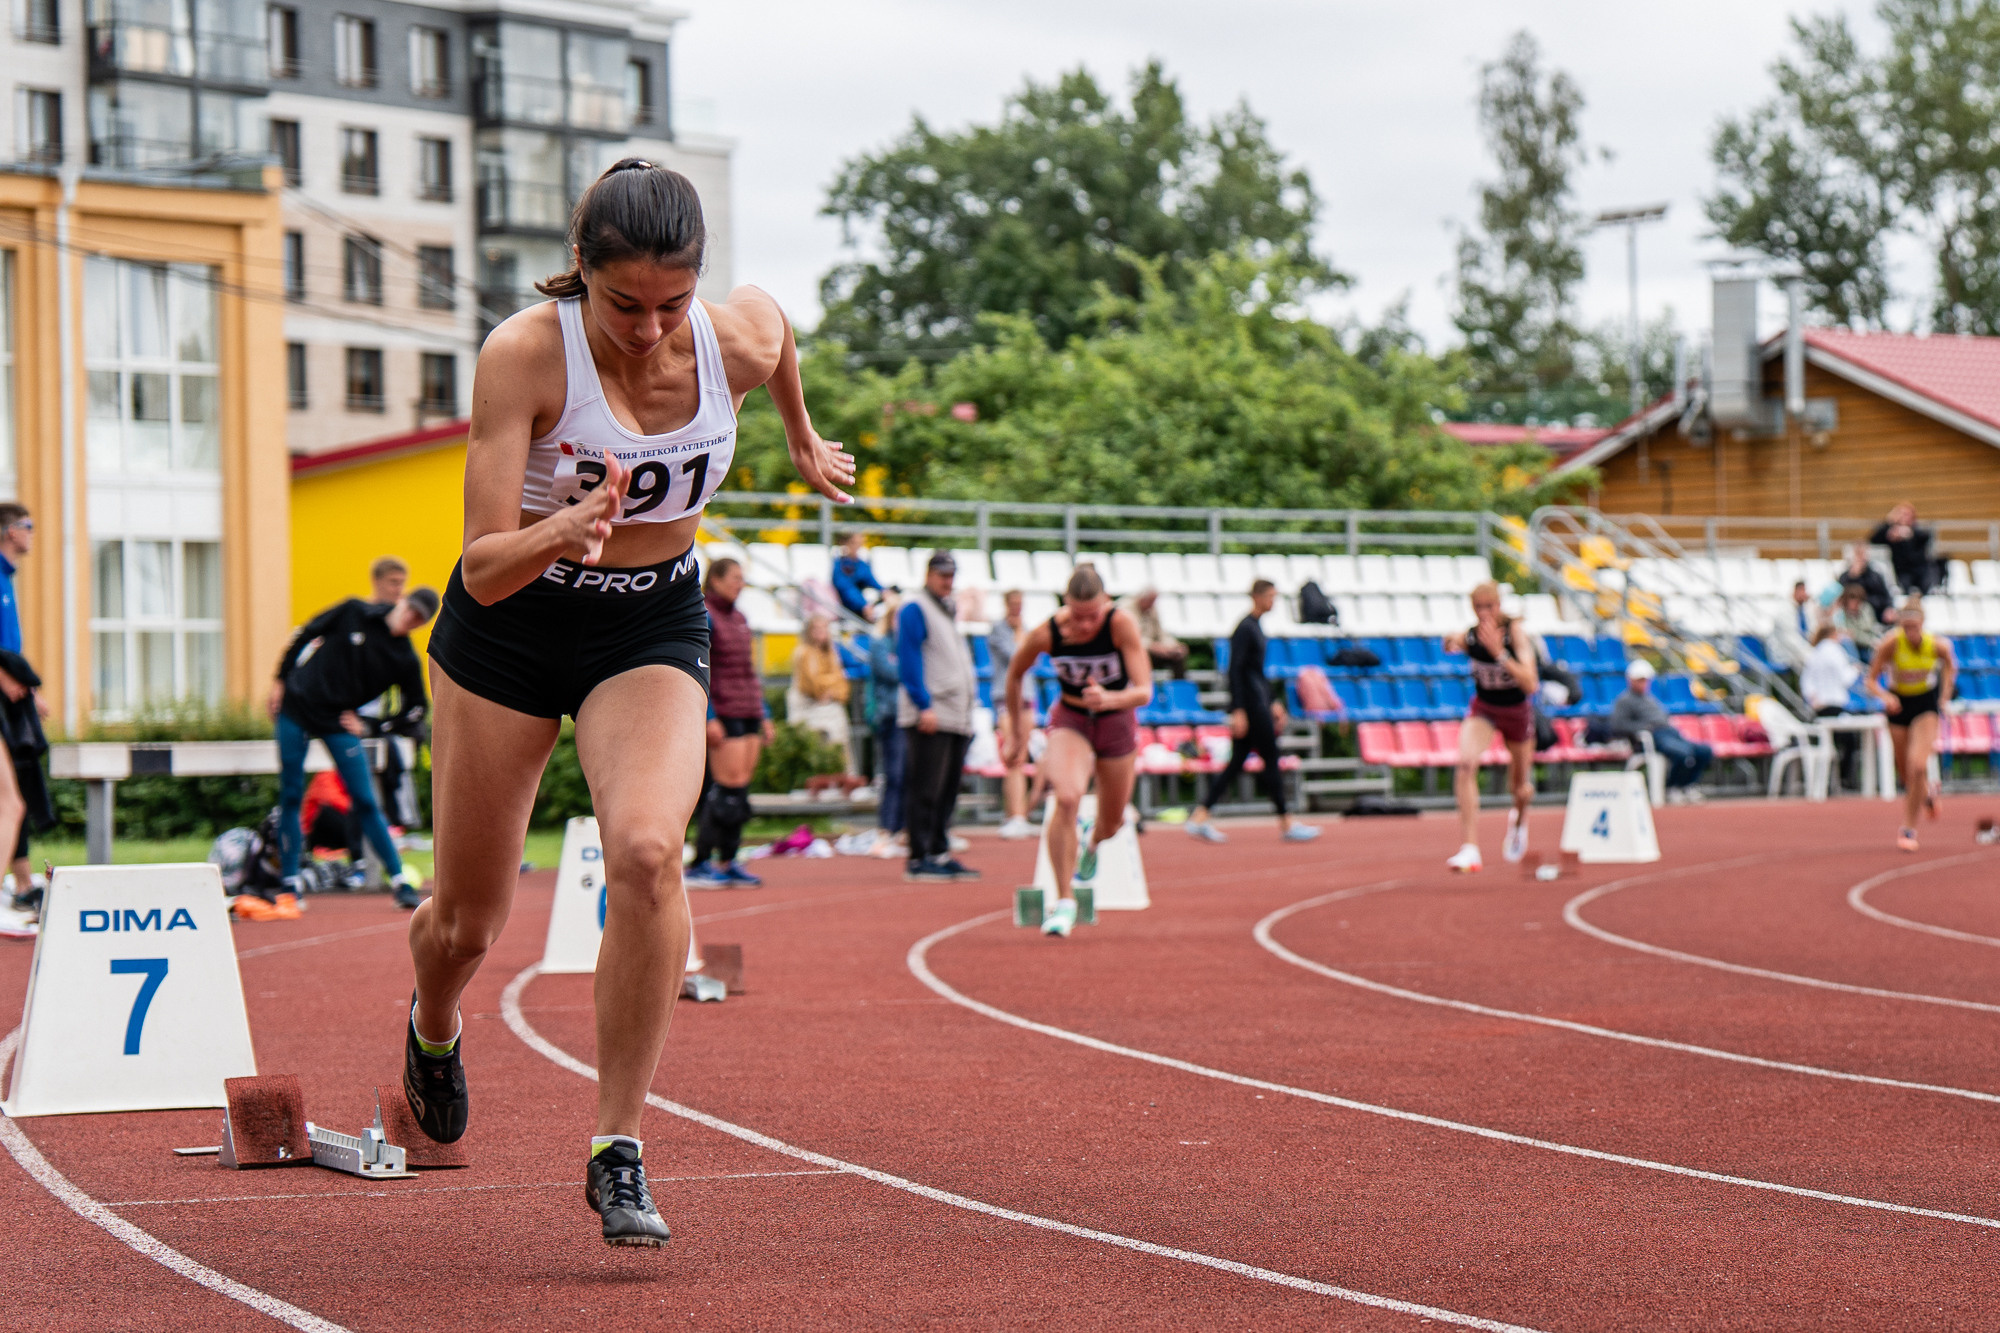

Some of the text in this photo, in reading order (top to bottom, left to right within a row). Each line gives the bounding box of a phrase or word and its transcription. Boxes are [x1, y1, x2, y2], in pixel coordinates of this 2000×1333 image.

[576, 435, 727, 459] АКАДМИЯ ЛЕГКОЙ АТЛЕТИКИ
[565, 452, 710, 518] 391
[573, 571, 658, 593] PRO
[1592, 809, 1609, 838] 4
[79, 908, 197, 932] DIMA
[110, 958, 168, 1055] 7
